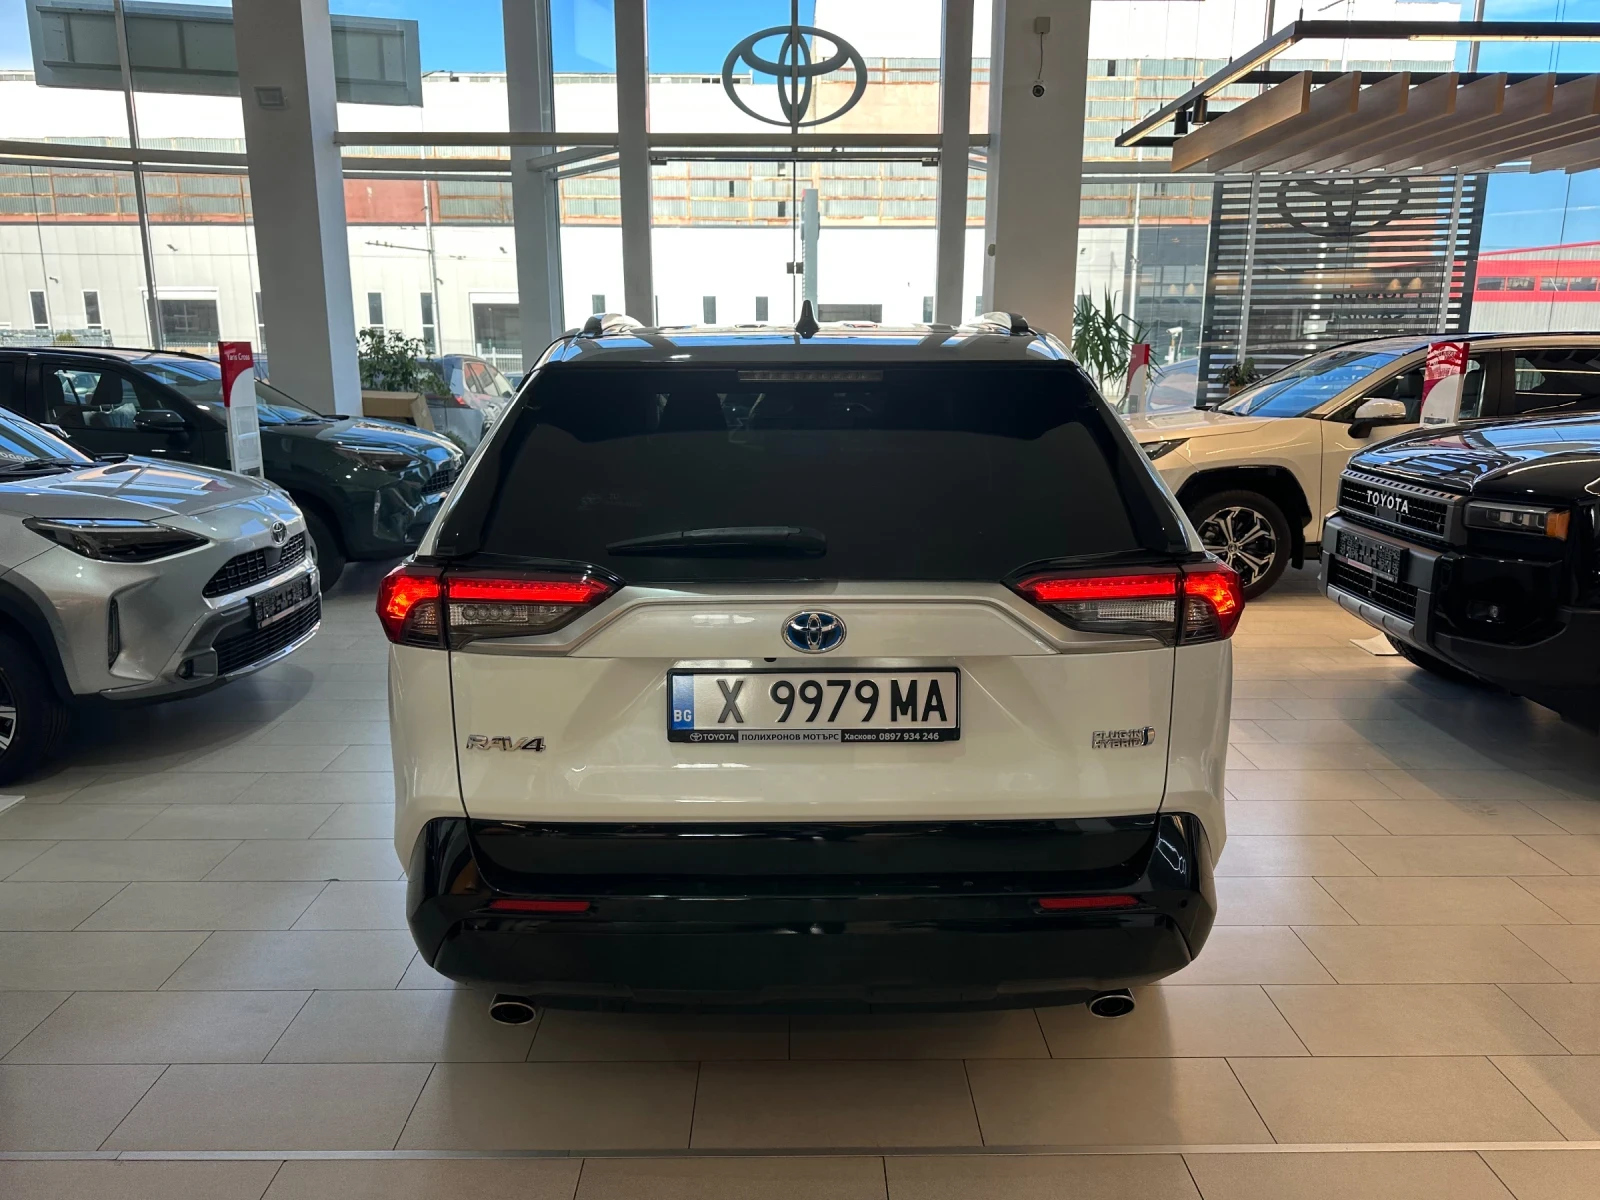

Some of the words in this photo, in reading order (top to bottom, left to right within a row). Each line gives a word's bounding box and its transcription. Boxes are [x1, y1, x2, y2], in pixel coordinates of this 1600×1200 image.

[1366, 490, 1409, 514] TOYOTA
[716, 679, 744, 723] X
[769, 680, 879, 723] 9979
[890, 679, 948, 722] MA
[673, 709, 692, 722] BG
[466, 734, 546, 752] RAV4
[703, 733, 736, 741] TOYOTA
[741, 733, 801, 741] ПОЛИХРОНОВ
[802, 732, 840, 741] МОТЪРС
[878, 732, 901, 741] 0897
[903, 732, 921, 741] 934
[922, 732, 940, 741] 246
[1091, 738, 1143, 749] HYBRID
